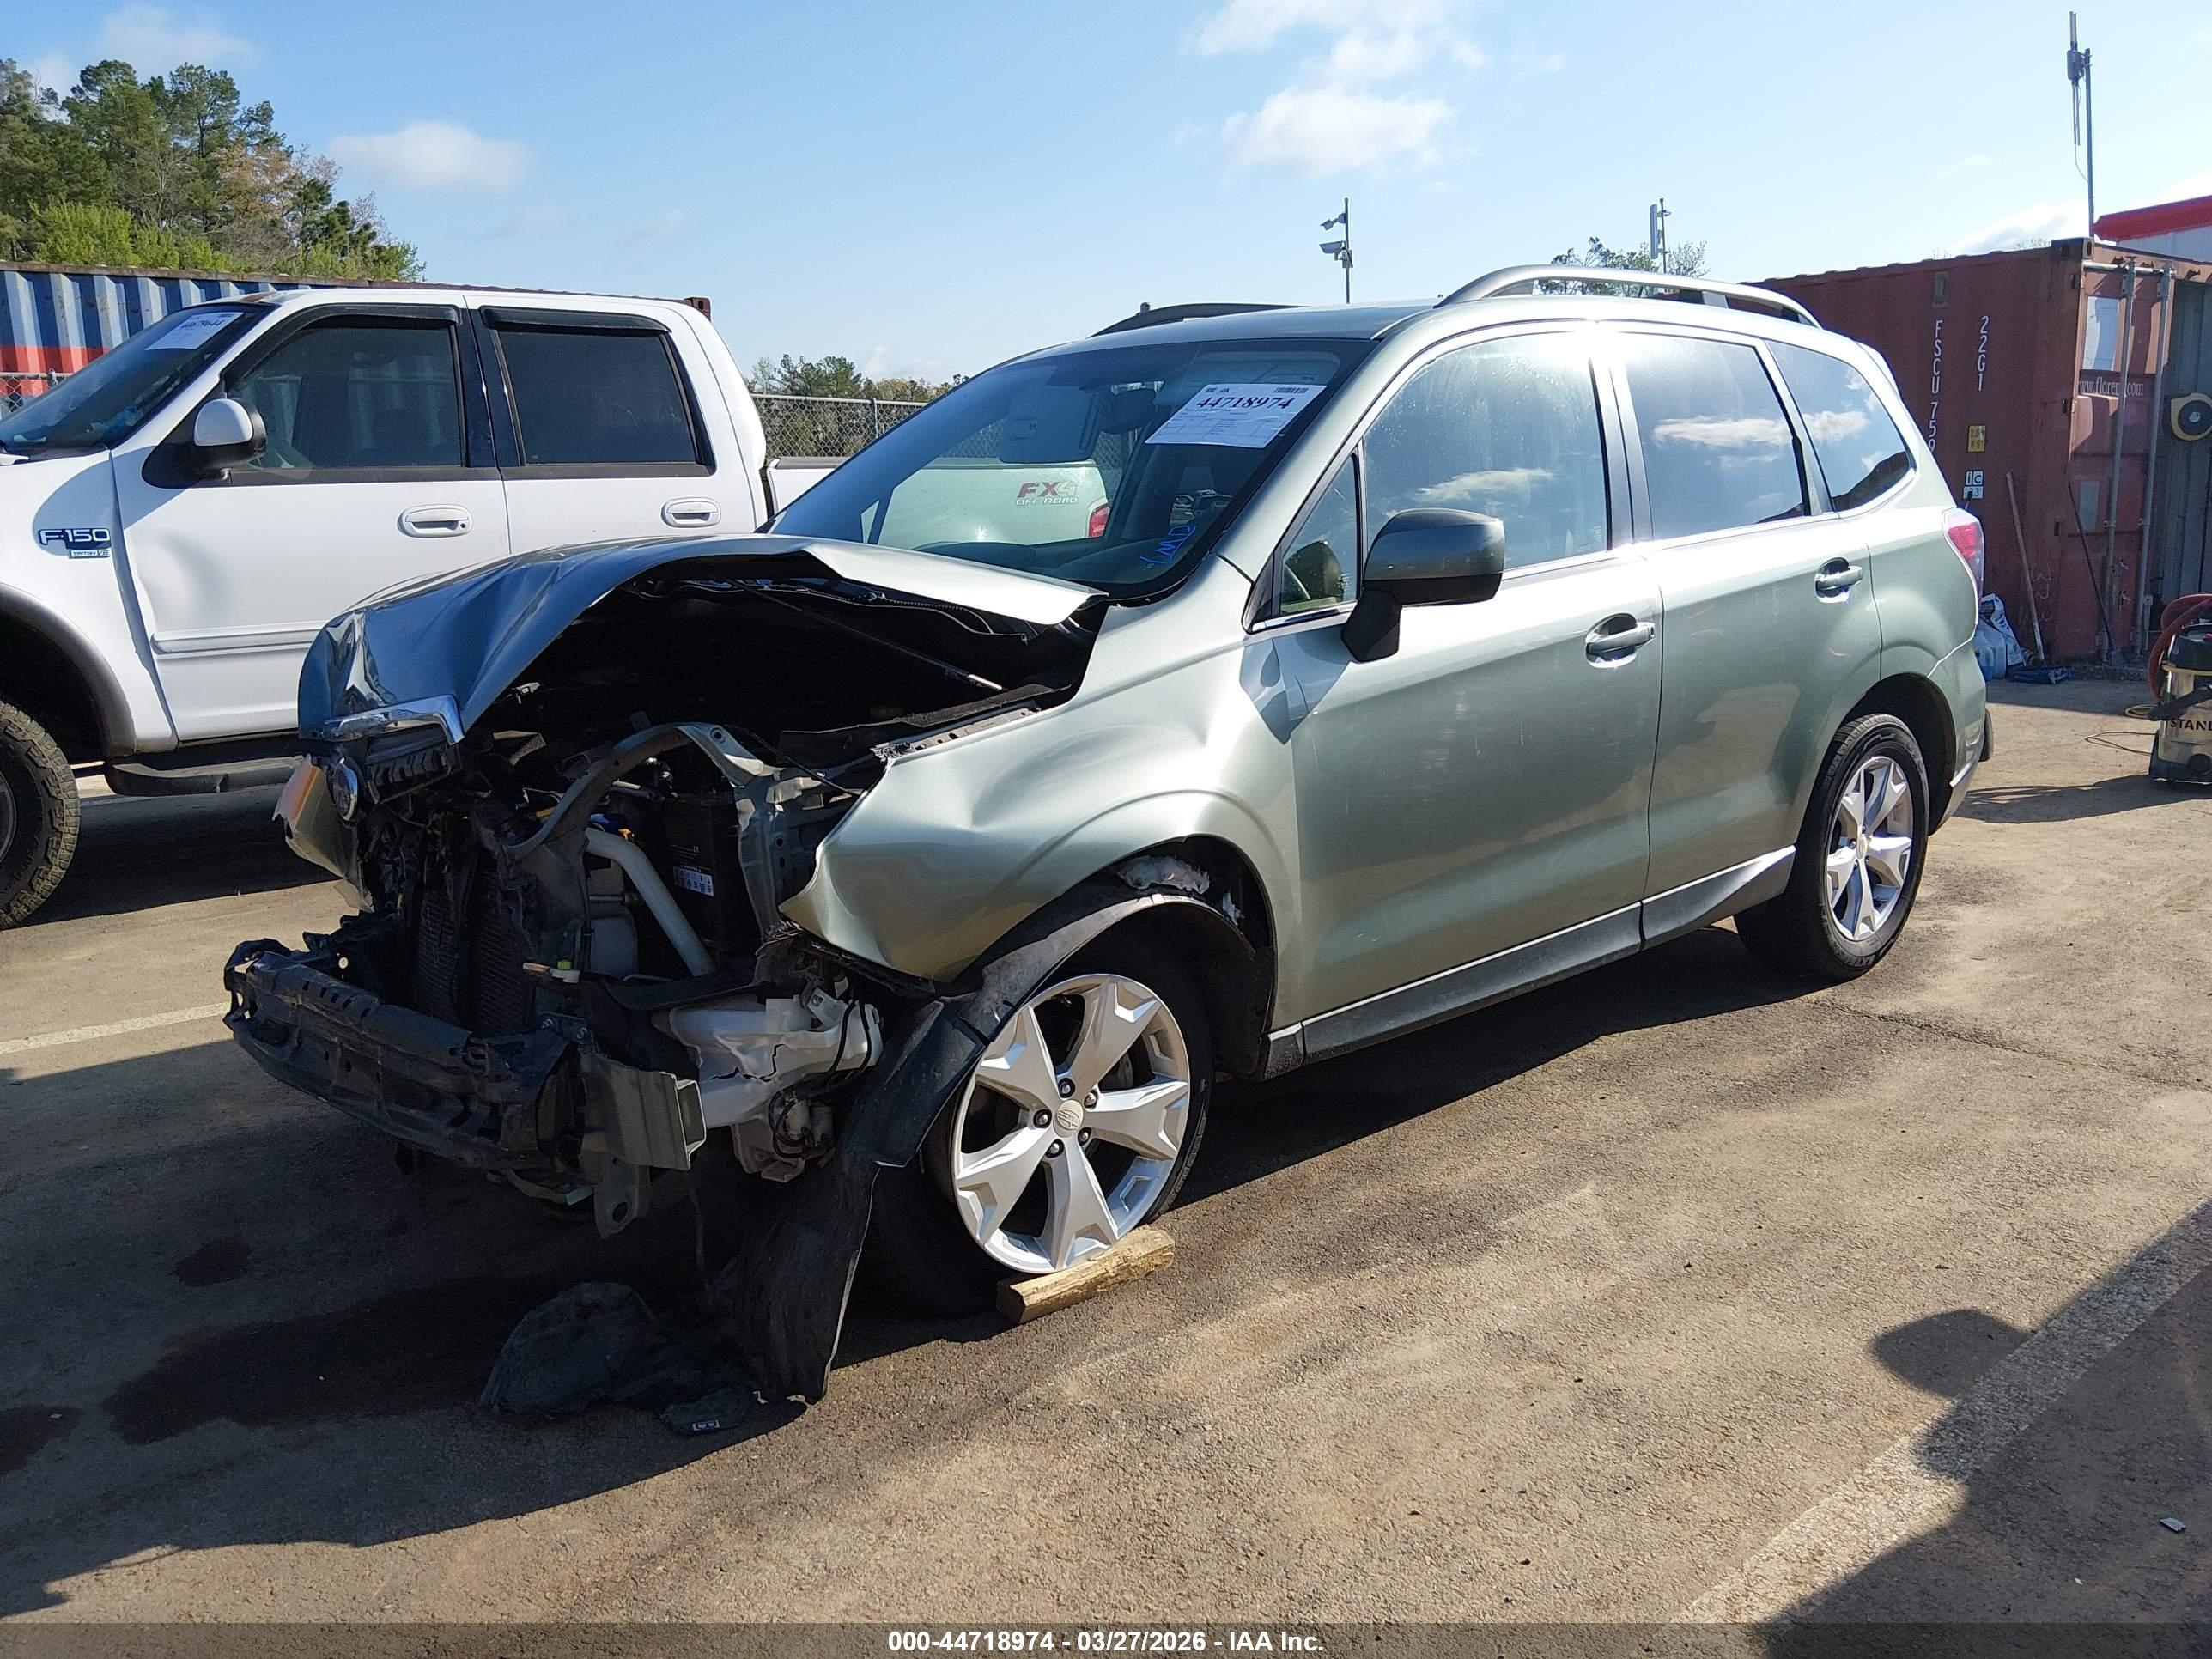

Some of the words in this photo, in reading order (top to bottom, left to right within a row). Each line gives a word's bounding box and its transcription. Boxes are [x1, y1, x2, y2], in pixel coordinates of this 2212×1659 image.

[1931, 319, 1943, 394] FSCU
[1978, 315, 1990, 392] 22G1
[1196, 396, 1295, 409] 44718974
[1018, 481, 1078, 499] FX4
